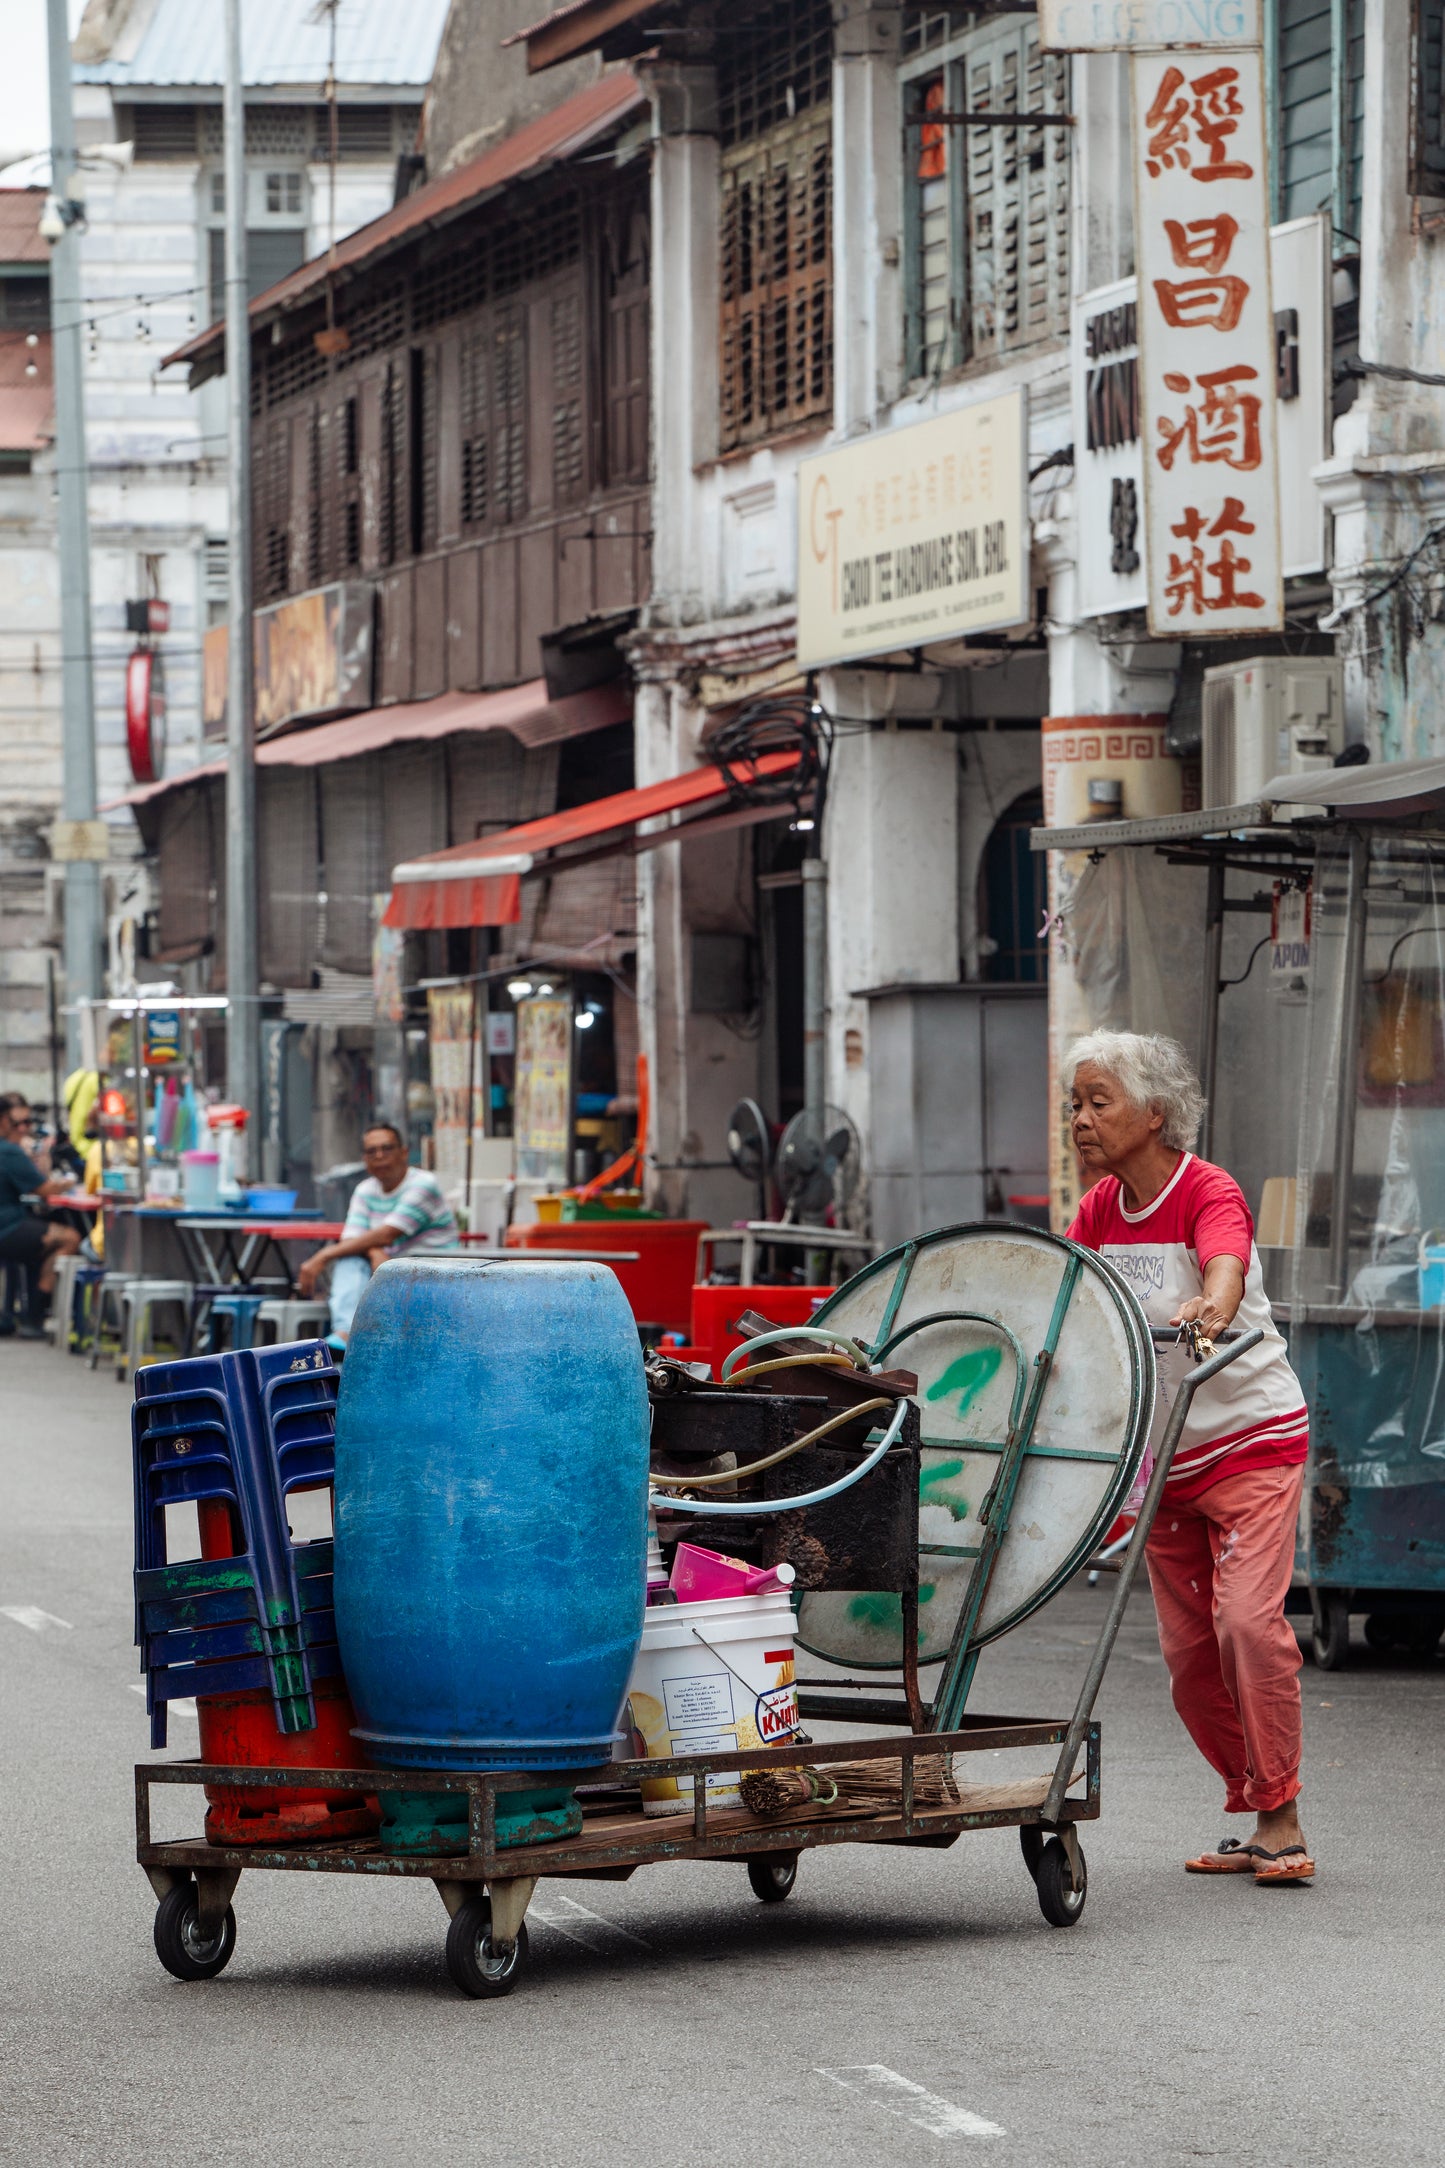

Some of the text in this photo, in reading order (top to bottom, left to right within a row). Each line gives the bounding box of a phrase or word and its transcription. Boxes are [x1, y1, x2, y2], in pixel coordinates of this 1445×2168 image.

[1145, 66, 1265, 617] 經昌酒莊
[843, 557, 871, 612] CHOO
[875, 551, 892, 604] TEE
[896, 534, 953, 599] HARDWARE
[956, 527, 980, 584] SDN.
